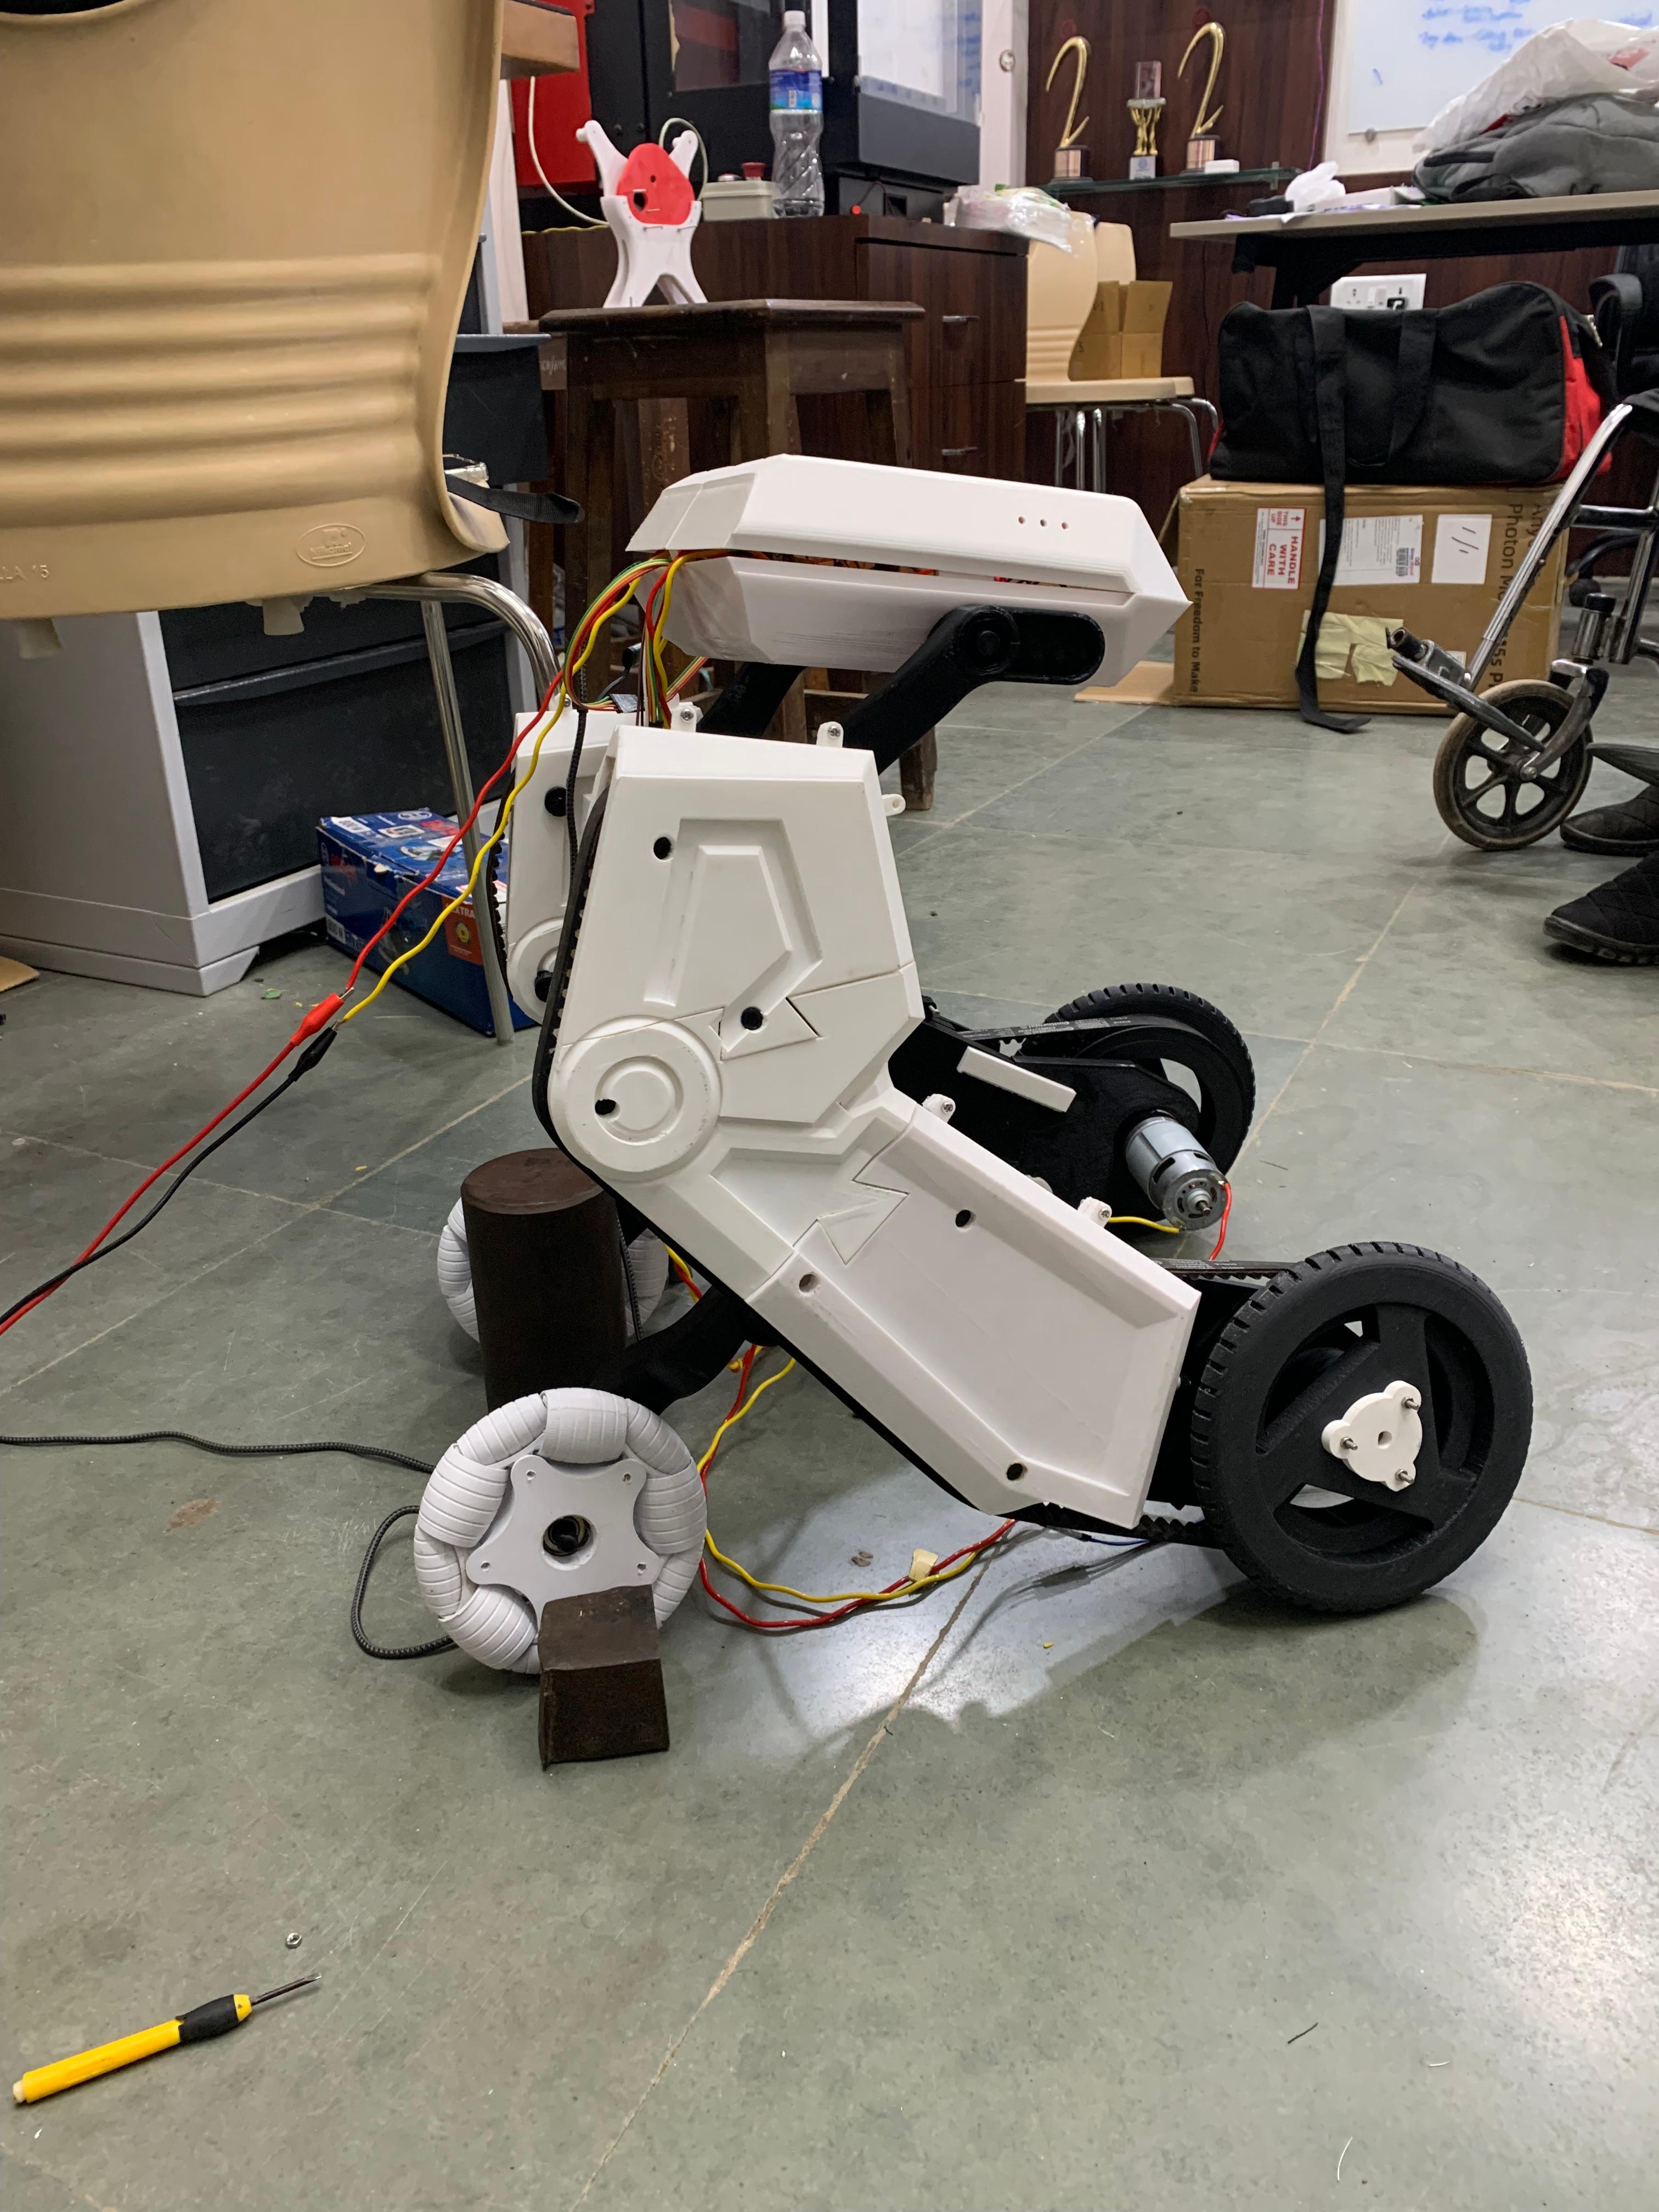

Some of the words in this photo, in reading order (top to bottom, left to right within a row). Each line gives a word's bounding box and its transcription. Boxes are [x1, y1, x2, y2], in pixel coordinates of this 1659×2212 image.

[1271, 514, 1276, 523] UP
[1502, 504, 1523, 569] Photon
[1267, 544, 1277, 575] CARE
[1278, 544, 1287, 575] WITH
[1288, 536, 1299, 584] HANDLE
[1194, 568, 1204, 588] For
[1193, 591, 1204, 643] Freedom
[1192, 647, 1201, 658] to
[1190, 661, 1201, 692] Make
